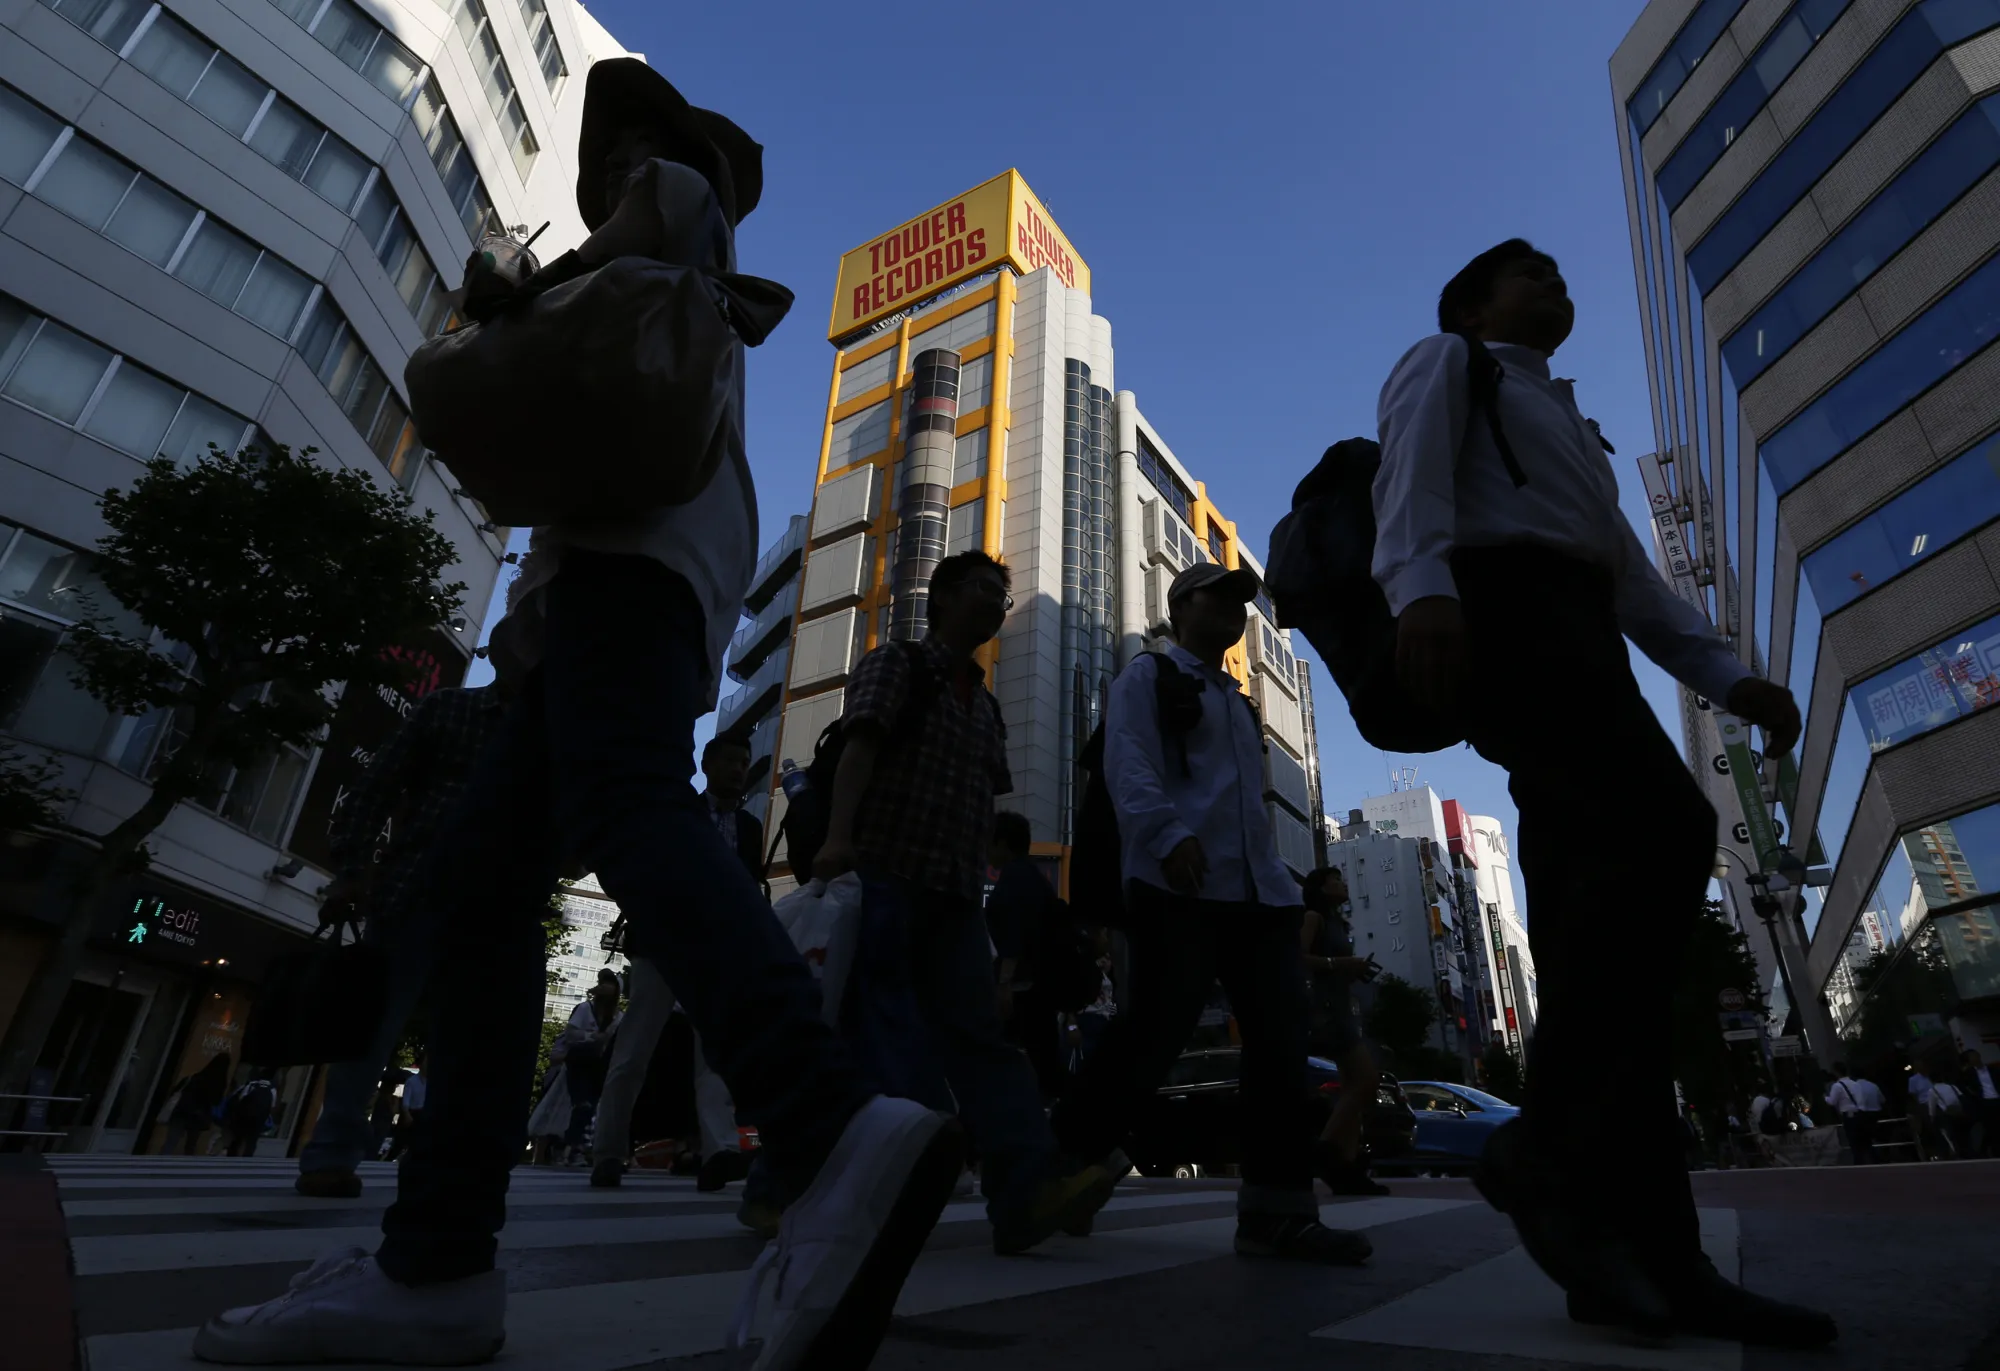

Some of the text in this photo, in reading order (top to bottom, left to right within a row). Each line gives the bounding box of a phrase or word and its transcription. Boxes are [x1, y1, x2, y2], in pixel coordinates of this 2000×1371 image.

[853, 227, 987, 320] RECORDS
[868, 201, 966, 275] TOWER
[1024, 200, 1075, 288] TOWER
[1660, 515, 1687, 572] 日本生命
